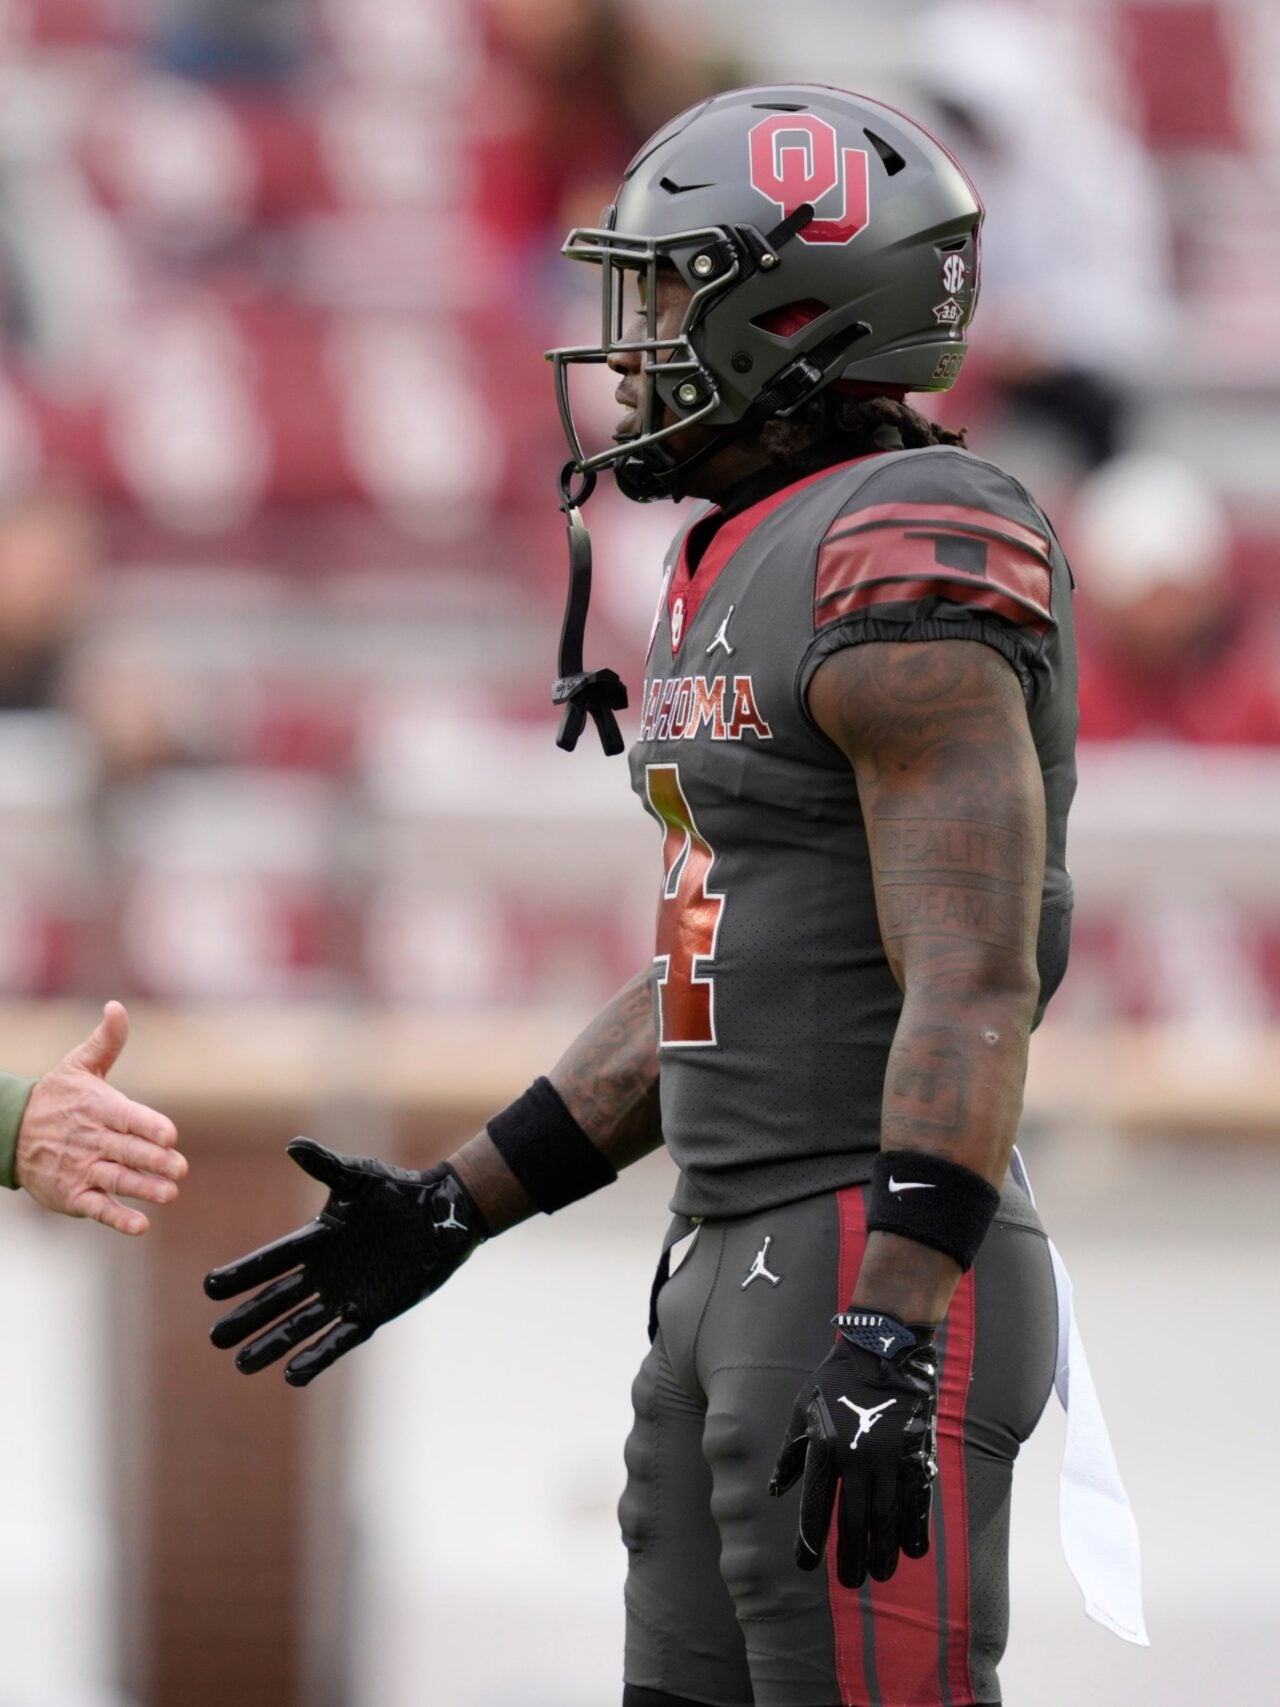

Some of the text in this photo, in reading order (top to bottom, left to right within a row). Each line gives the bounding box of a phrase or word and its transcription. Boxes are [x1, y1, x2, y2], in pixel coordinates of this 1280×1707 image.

[748, 113, 869, 246] OU
[943, 254, 965, 294] SEC
[636, 675, 773, 742] AHOMA
[646, 763, 725, 1047] 4
[838, 1315, 883, 1326] JORDAN
